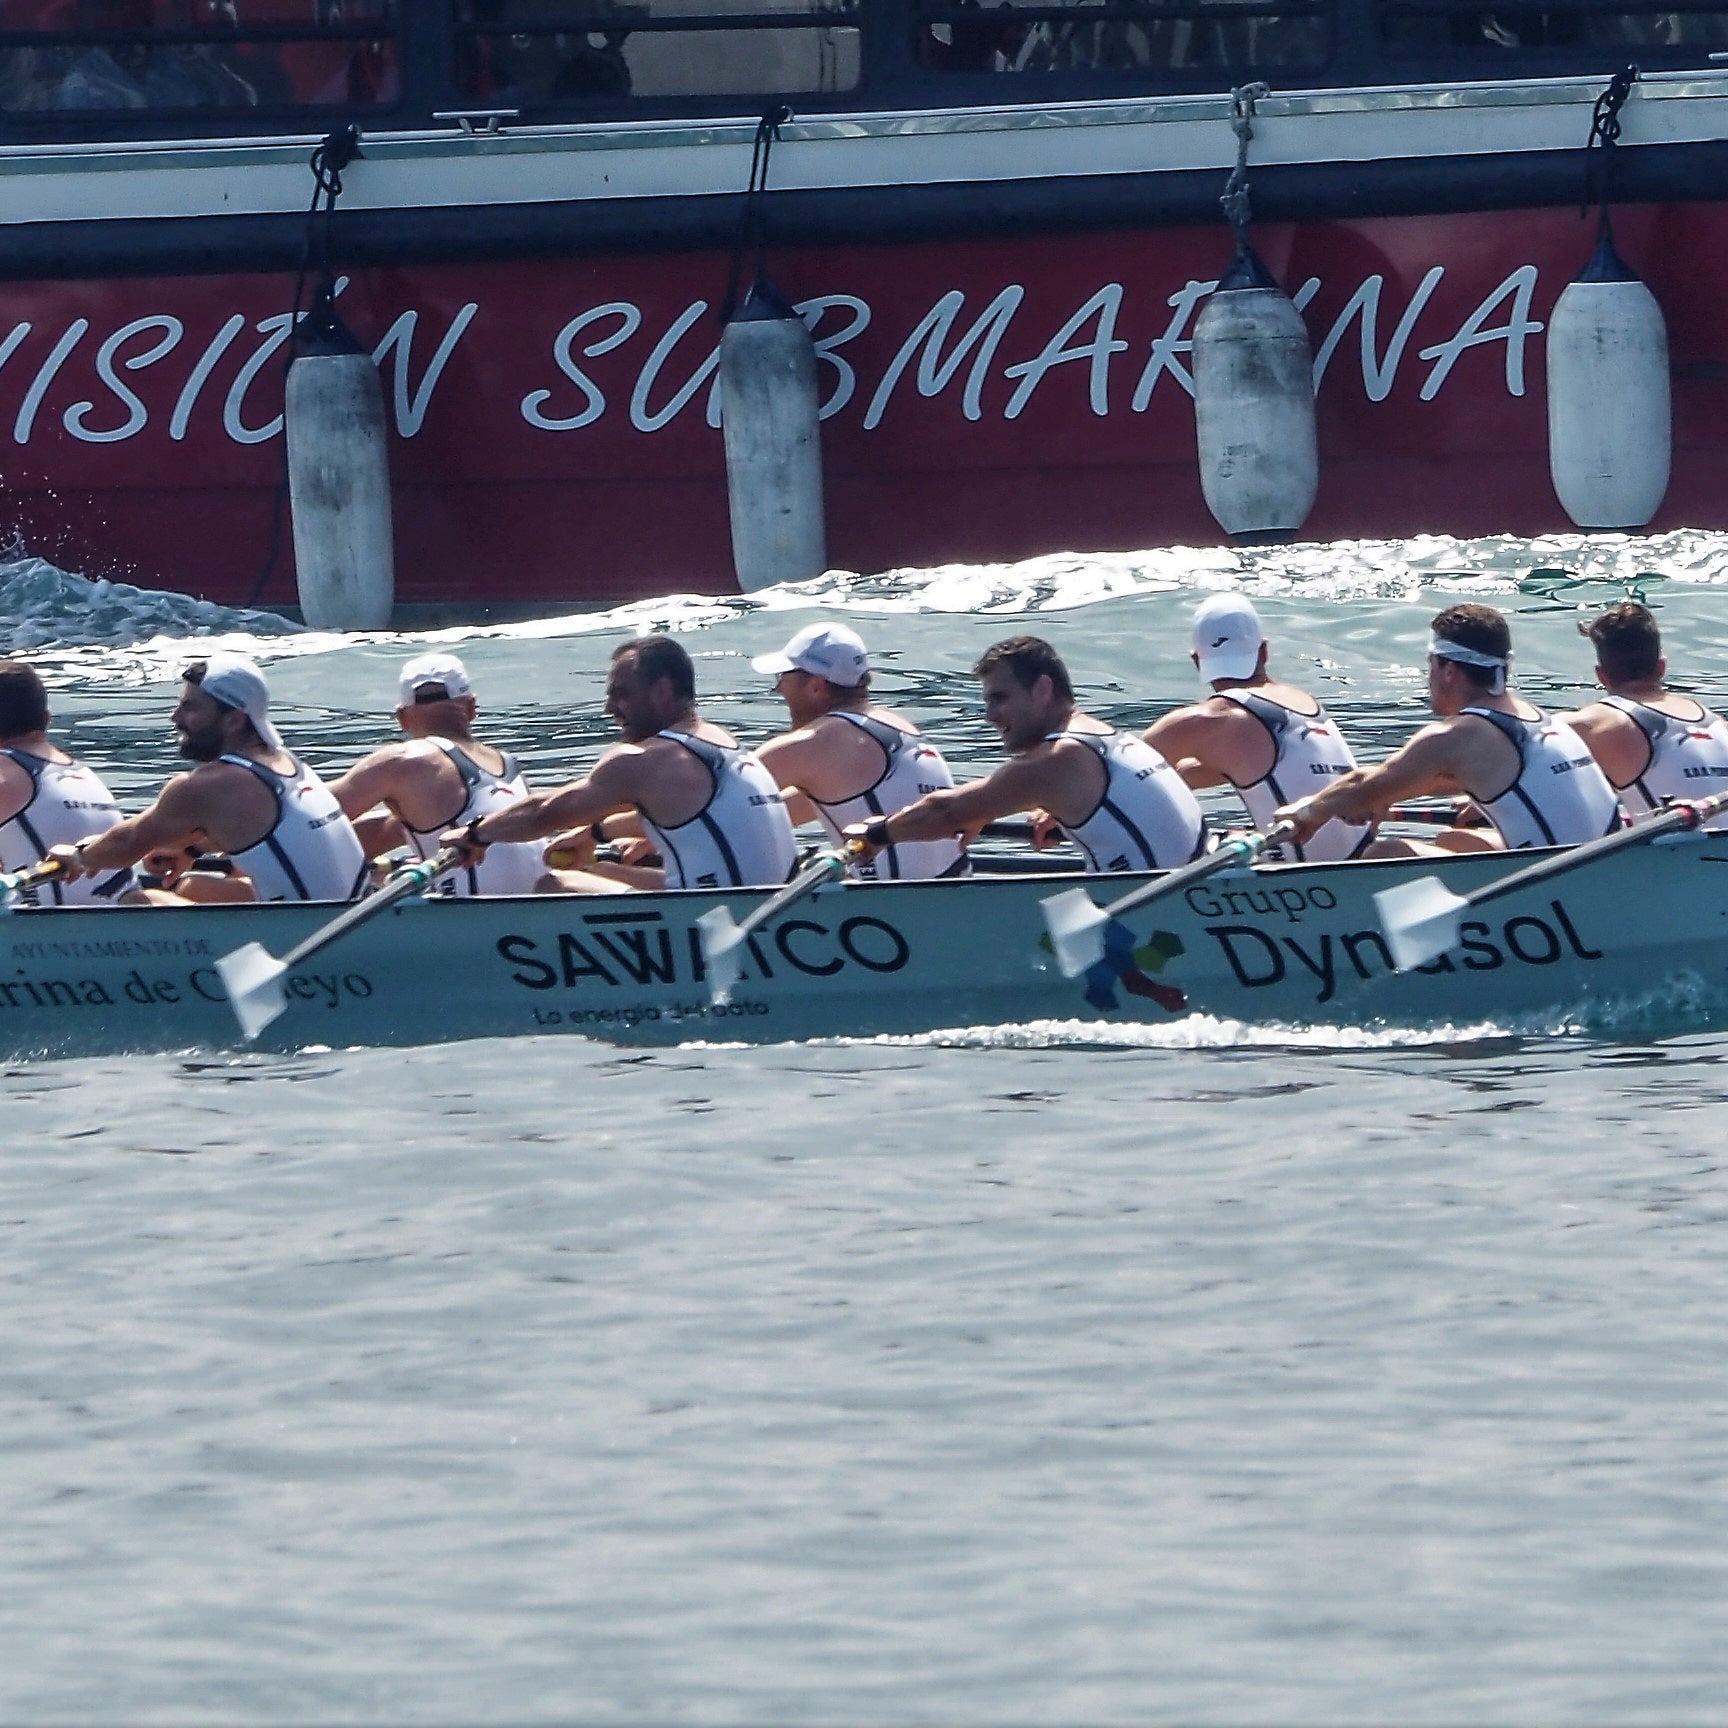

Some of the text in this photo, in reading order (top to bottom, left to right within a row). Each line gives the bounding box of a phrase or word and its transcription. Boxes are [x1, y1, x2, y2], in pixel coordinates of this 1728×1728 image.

[1183, 882, 1337, 923] Grupo
[11, 938, 213, 961] AYUNTAMIENTO DE
[1204, 899, 1605, 1004] Dynsol
[124, 969, 179, 1006] de
